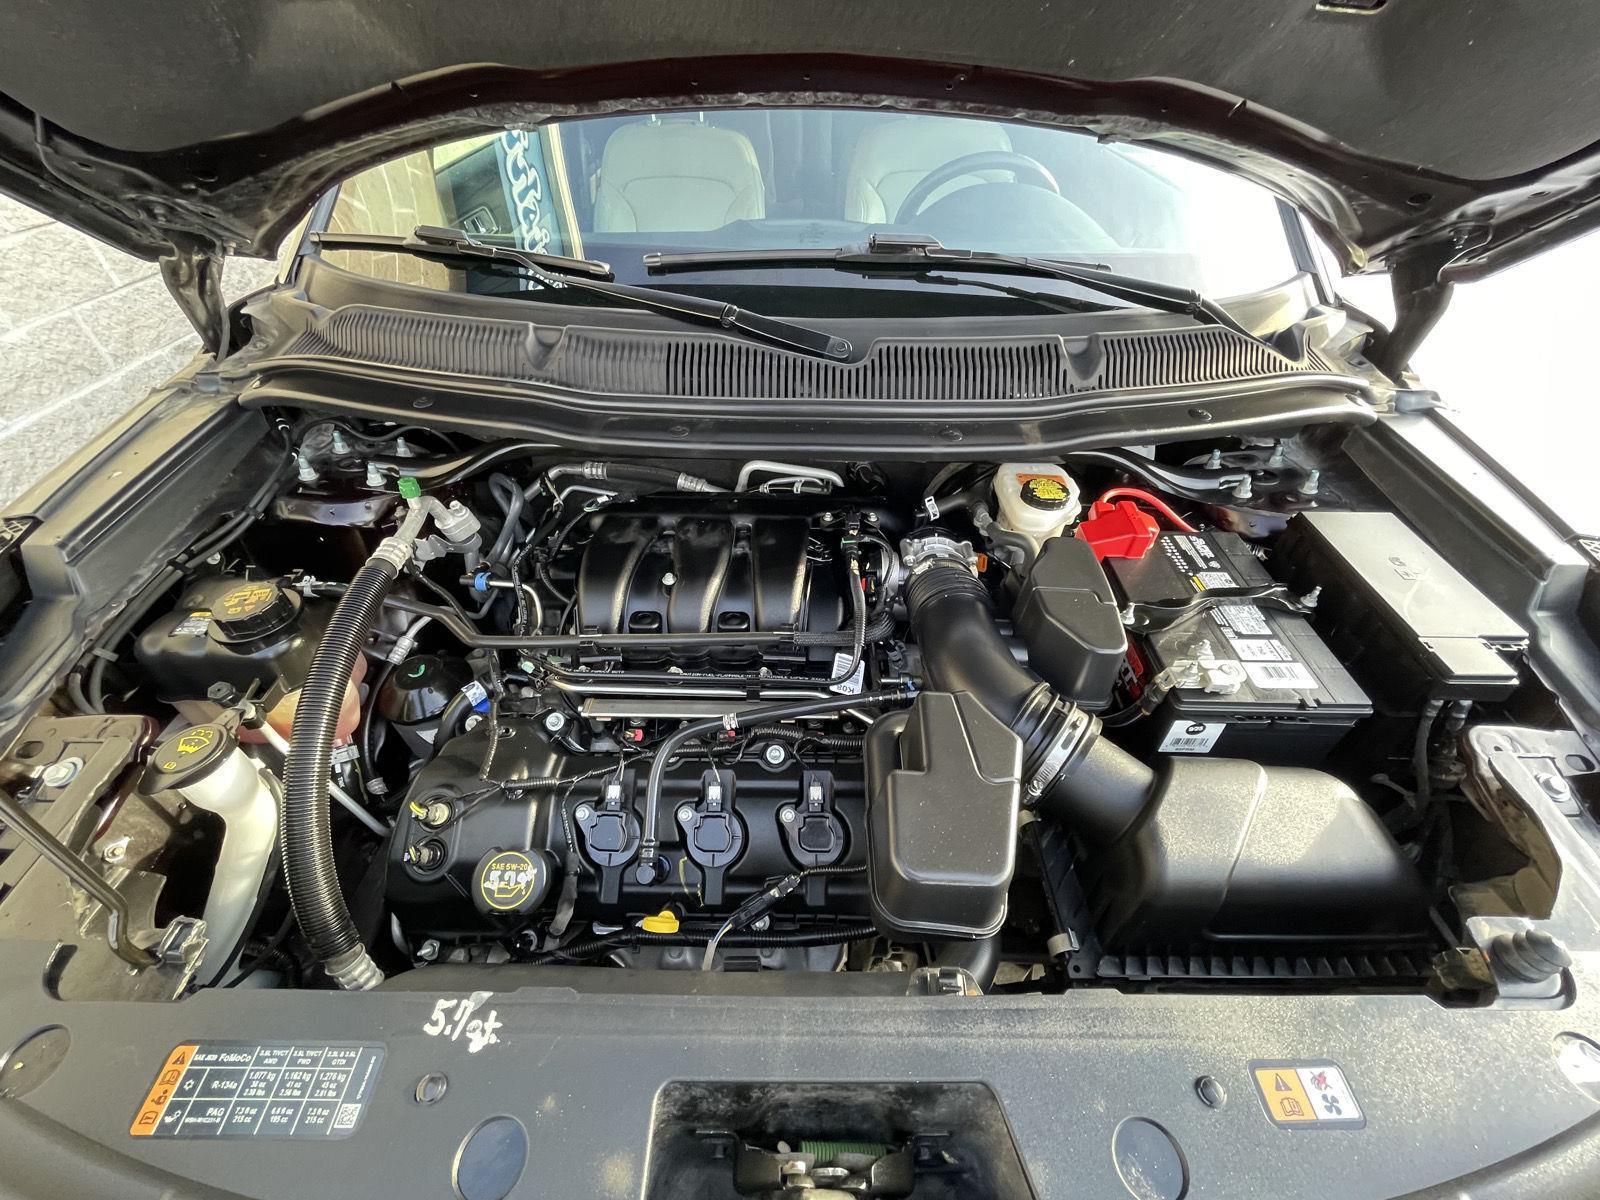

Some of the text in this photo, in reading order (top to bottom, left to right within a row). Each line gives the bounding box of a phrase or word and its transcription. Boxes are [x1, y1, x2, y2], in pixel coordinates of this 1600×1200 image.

[491, 863, 528, 871] SAE 5W-20
[218, 1053, 252, 1062] FoMoCo
[249, 1071, 277, 1082] 1.077 kg
[302, 1072, 312, 1082] kg
[320, 1071, 347, 1083] 1.276 kg
[211, 1080, 238, 1089] R-134a
[206, 1107, 225, 1116] PAG
